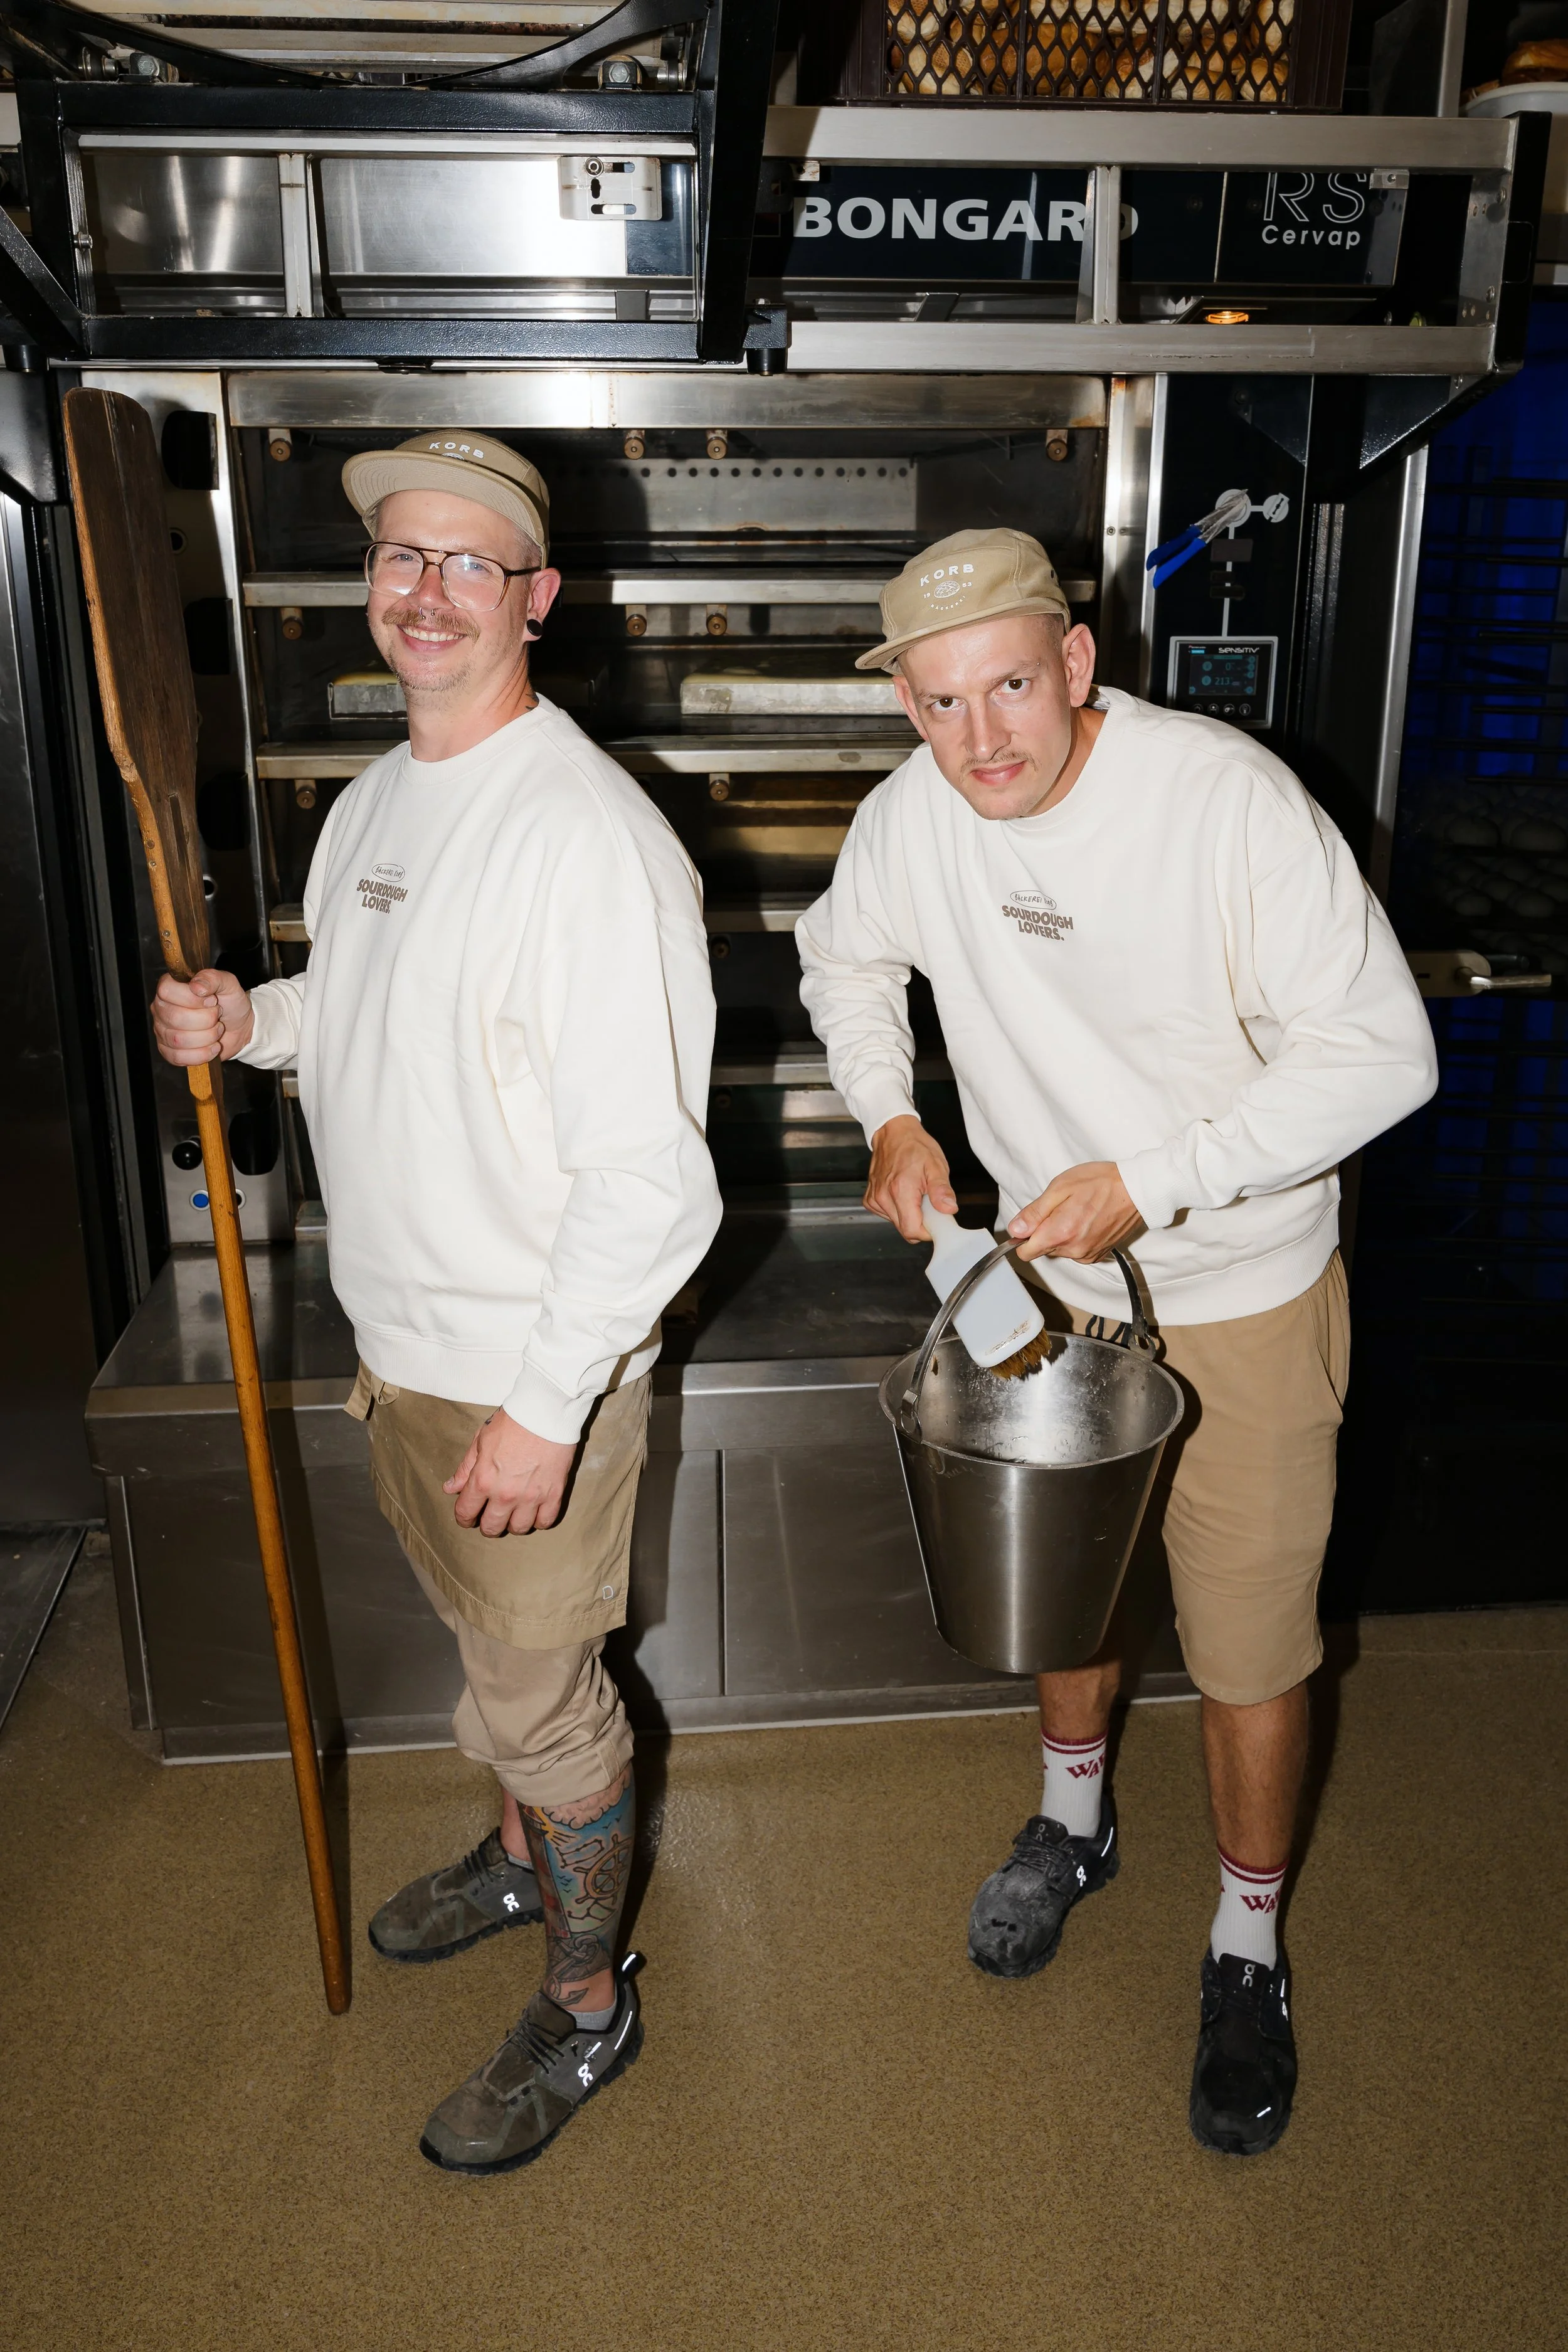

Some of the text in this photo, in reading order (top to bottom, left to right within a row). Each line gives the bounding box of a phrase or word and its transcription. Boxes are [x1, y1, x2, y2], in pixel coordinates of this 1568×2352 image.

[1263, 172, 1367, 223] RS
[1262, 225, 1360, 250] Cervap
[429, 442, 484, 458] KORB
[920, 564, 974, 587] KORB
[356, 879, 408, 903] SOURDOUGH
[361, 894, 392, 914] LOVERS.
[1002, 905, 1074, 930] SOURDOUGH
[1017, 919, 1065, 941] LOVERS.
